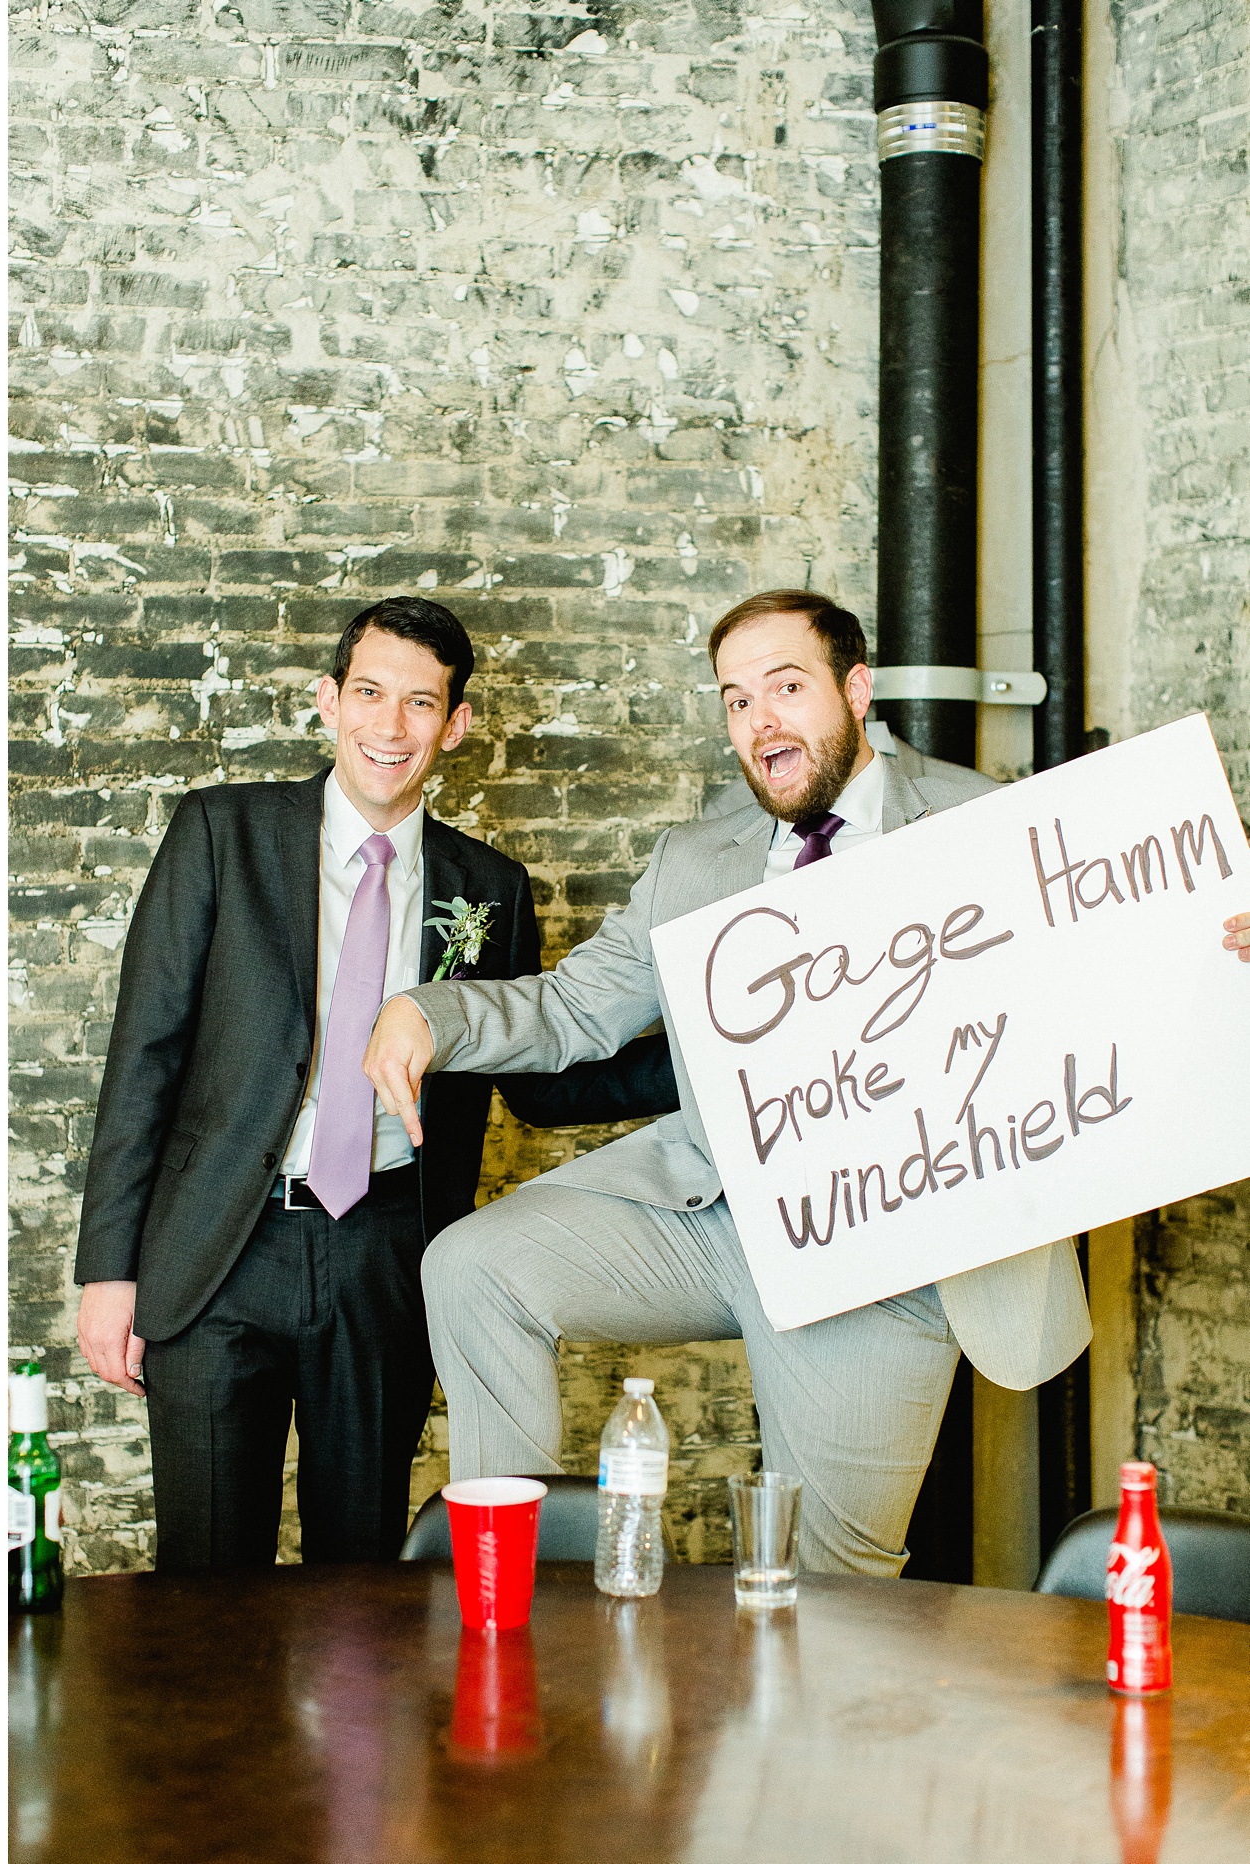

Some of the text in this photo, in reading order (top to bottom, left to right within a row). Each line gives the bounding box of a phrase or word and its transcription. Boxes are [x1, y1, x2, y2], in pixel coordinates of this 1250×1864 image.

[705, 813, 1234, 1044] Gage Hamm
[737, 1012, 1009, 1165] broke my
[776, 1042, 1134, 1251] windshield
